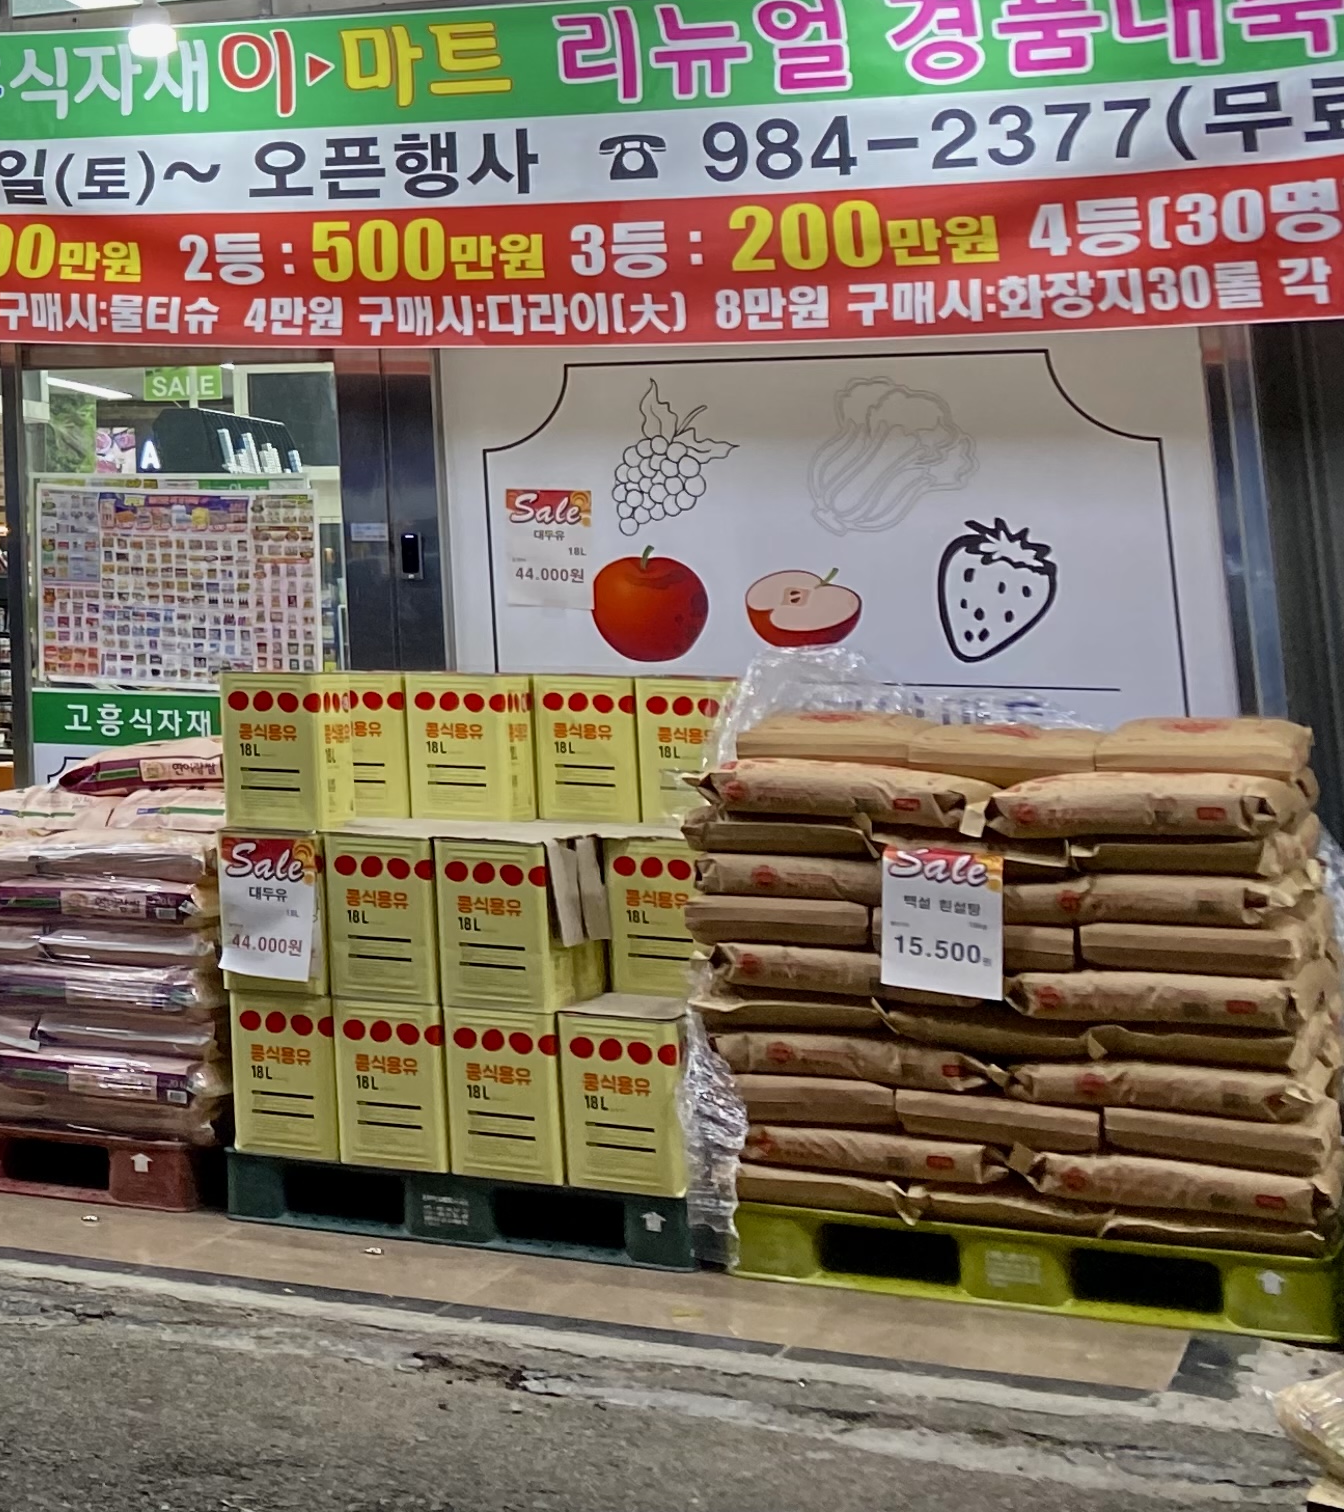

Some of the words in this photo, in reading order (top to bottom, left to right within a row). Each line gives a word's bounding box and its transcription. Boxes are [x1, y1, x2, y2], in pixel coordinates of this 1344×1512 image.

[9, 39, 209, 119] 식자재
[341, 22, 512, 107] 마트
[248, 128, 540, 200] 오픈행사
[312, 218, 545, 283] 500만원
[729, 199, 1001, 273] 200만원
[244, 295, 343, 337] 4만원
[715, 285, 830, 331] 8만원
[1277, 257, 1332, 304] 각
[510, 493, 582, 525] Sale
[533, 530, 565, 541] 대두유
[568, 547, 587, 556] 18L
[515, 567, 584, 583] 44.000원
[64, 703, 212, 737] 고흥식자재
[226, 842, 305, 883] Sale
[888, 848, 988, 886] Sale
[249, 886, 288, 903] 대두유
[232, 933, 303, 957] 44.000원
